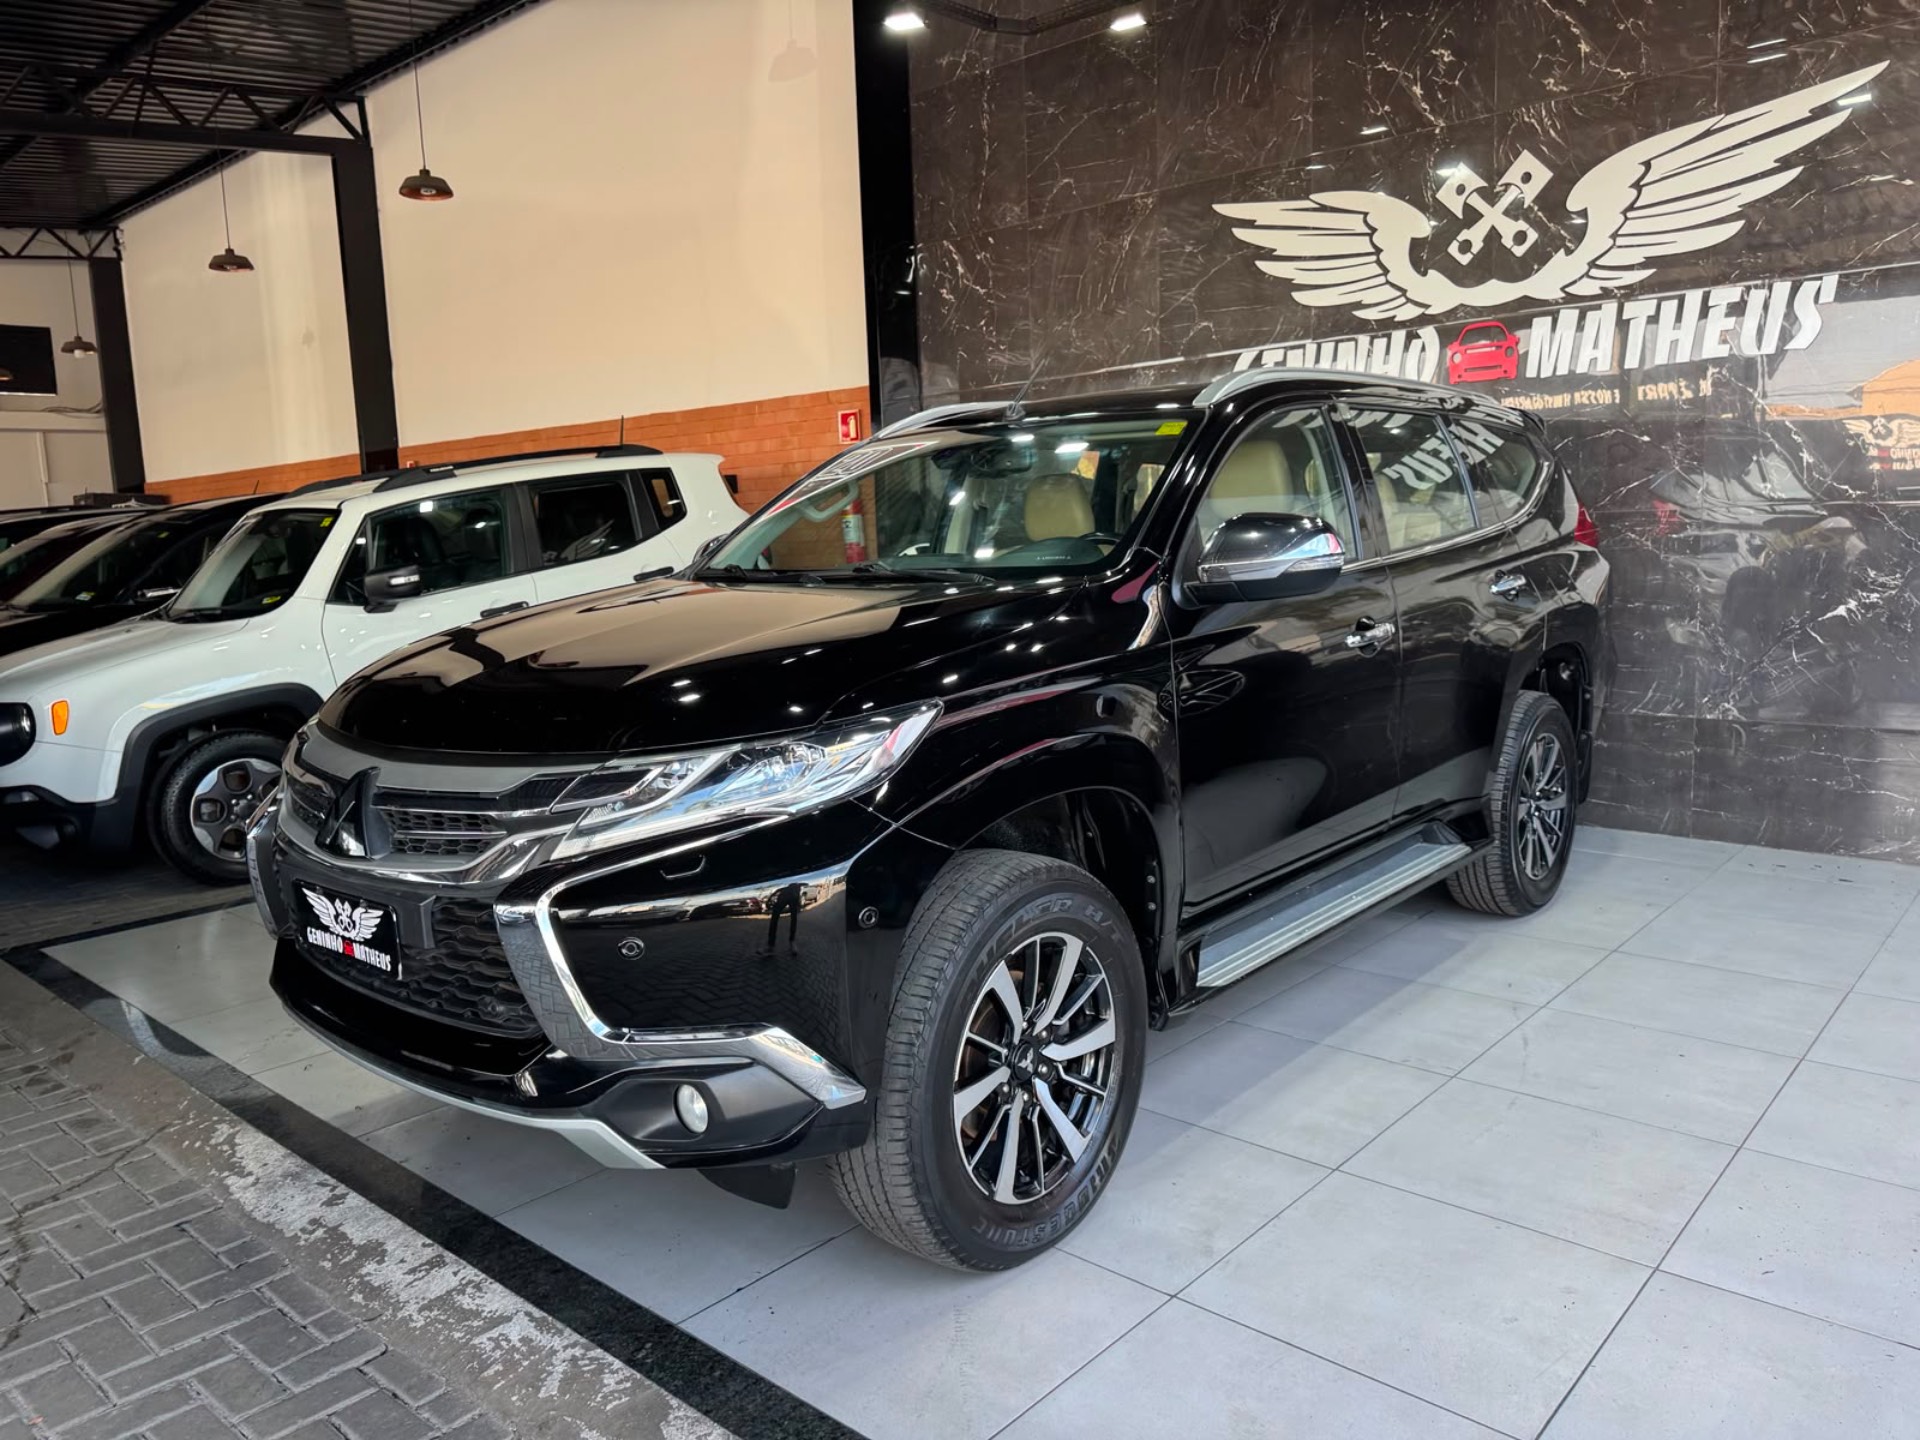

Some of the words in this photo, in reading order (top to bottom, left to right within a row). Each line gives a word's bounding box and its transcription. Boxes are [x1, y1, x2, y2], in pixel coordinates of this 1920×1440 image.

[1525, 274, 1839, 379] MATHEUS
[306, 926, 344, 954] GEMINHO
[352, 942, 392, 972] MATHEUS
